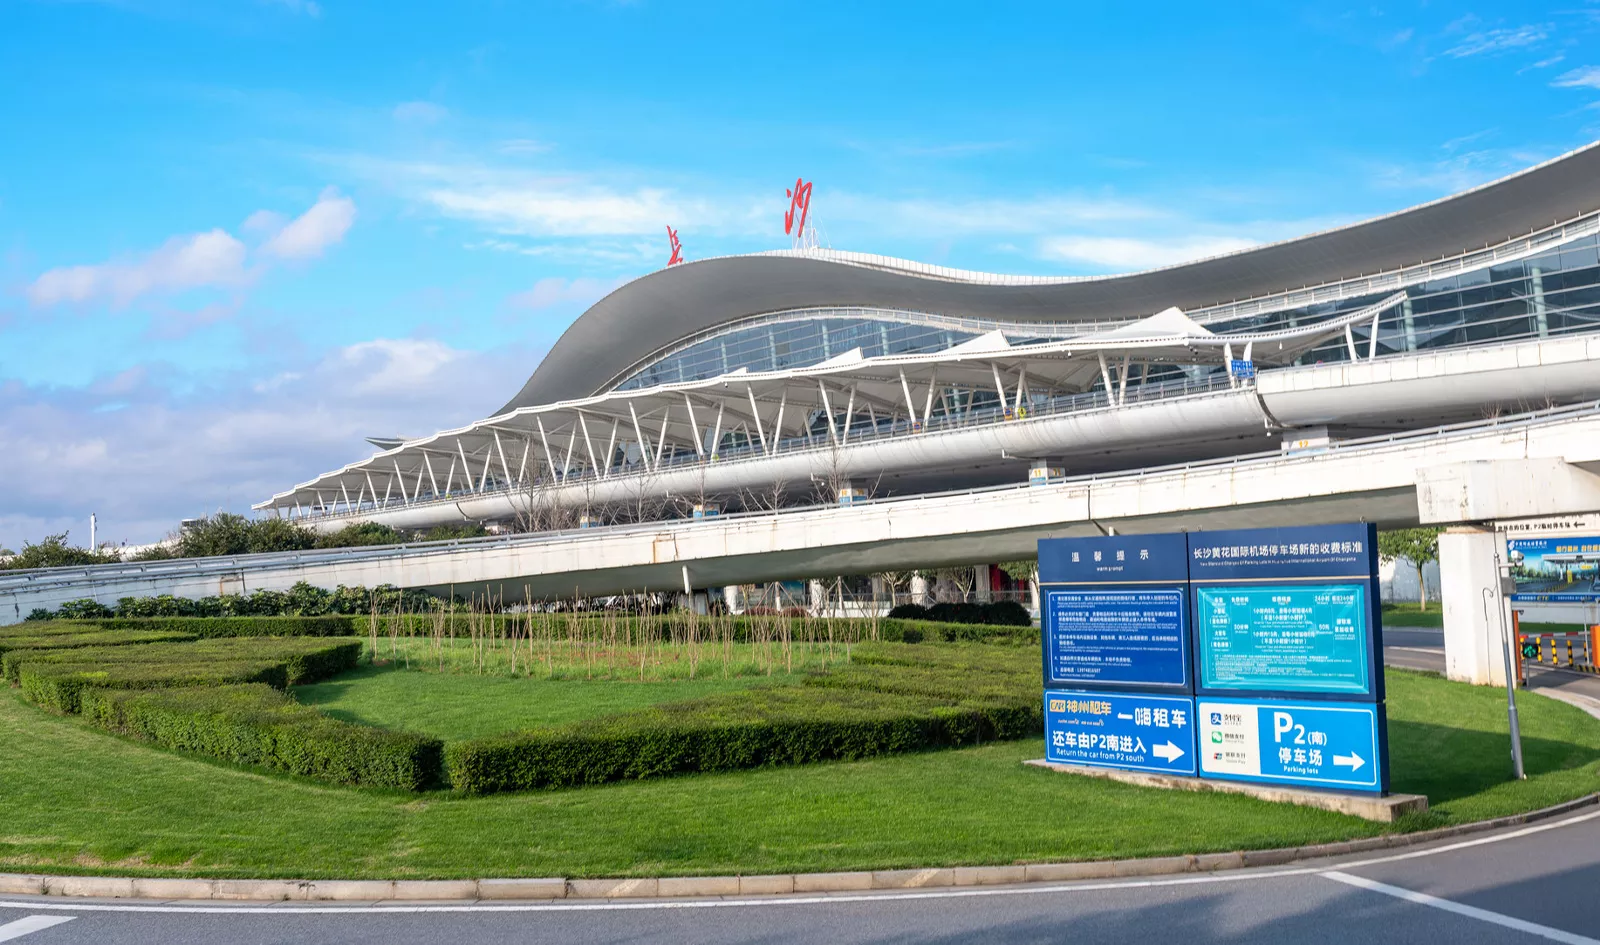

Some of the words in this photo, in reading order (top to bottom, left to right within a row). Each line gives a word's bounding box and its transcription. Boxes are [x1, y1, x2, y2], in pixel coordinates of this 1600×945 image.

[1194, 541, 1362, 559] 长沙黄花国际机场停车场新的收费标准
[1067, 700, 1111, 715] 神州租车
[1053, 730, 1146, 753] 还车由P2南进入
[1056, 747, 1076, 757] Return
[1077, 750, 1087, 758] the
[1100, 751, 1115, 760] from
[1117, 752, 1124, 762] P2
[1125, 754, 1144, 763] south
[1279, 747, 1322, 766] 停车场
[1284, 765, 1306, 774] Parking
